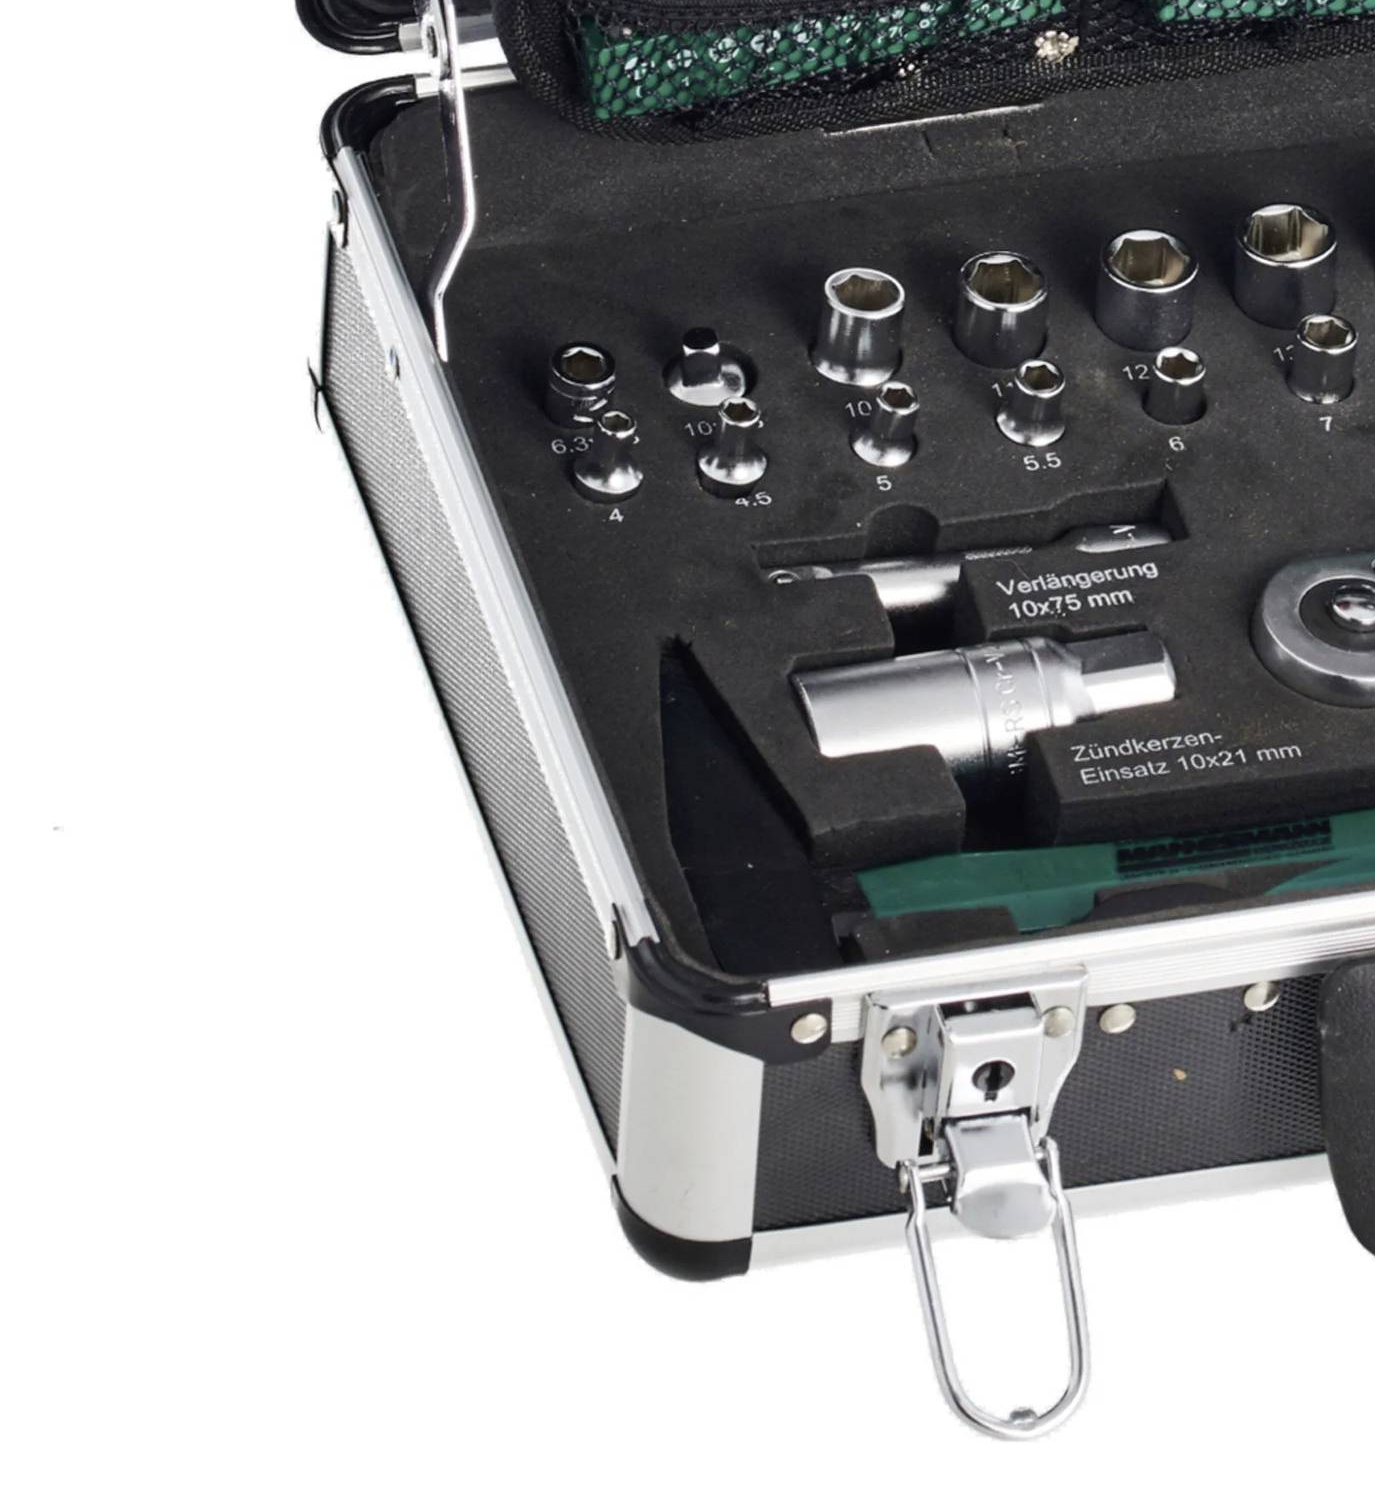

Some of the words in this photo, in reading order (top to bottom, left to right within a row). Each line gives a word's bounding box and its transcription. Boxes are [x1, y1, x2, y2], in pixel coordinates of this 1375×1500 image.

[1123, 364, 1150, 381] 12
[845, 400, 872, 418] 10
[1319, 416, 1333, 432] 7
[1168, 436, 1185, 451] 6
[1023, 452, 1062, 471] 5.5
[876, 475, 892, 491] 5
[735, 491, 773, 508] 4.5
[609, 508, 624, 523] 4
[995, 561, 1159, 597] Verlängerung
[1008, 593, 1082, 619] 10x75
[1086, 589, 1134, 609] mm
[1070, 731, 1224, 763] Zündkerzen-
[1080, 760, 1171, 785] Einsatz
[1177, 747, 1247, 772] 10x21
[1256, 744, 1302, 763] mm
